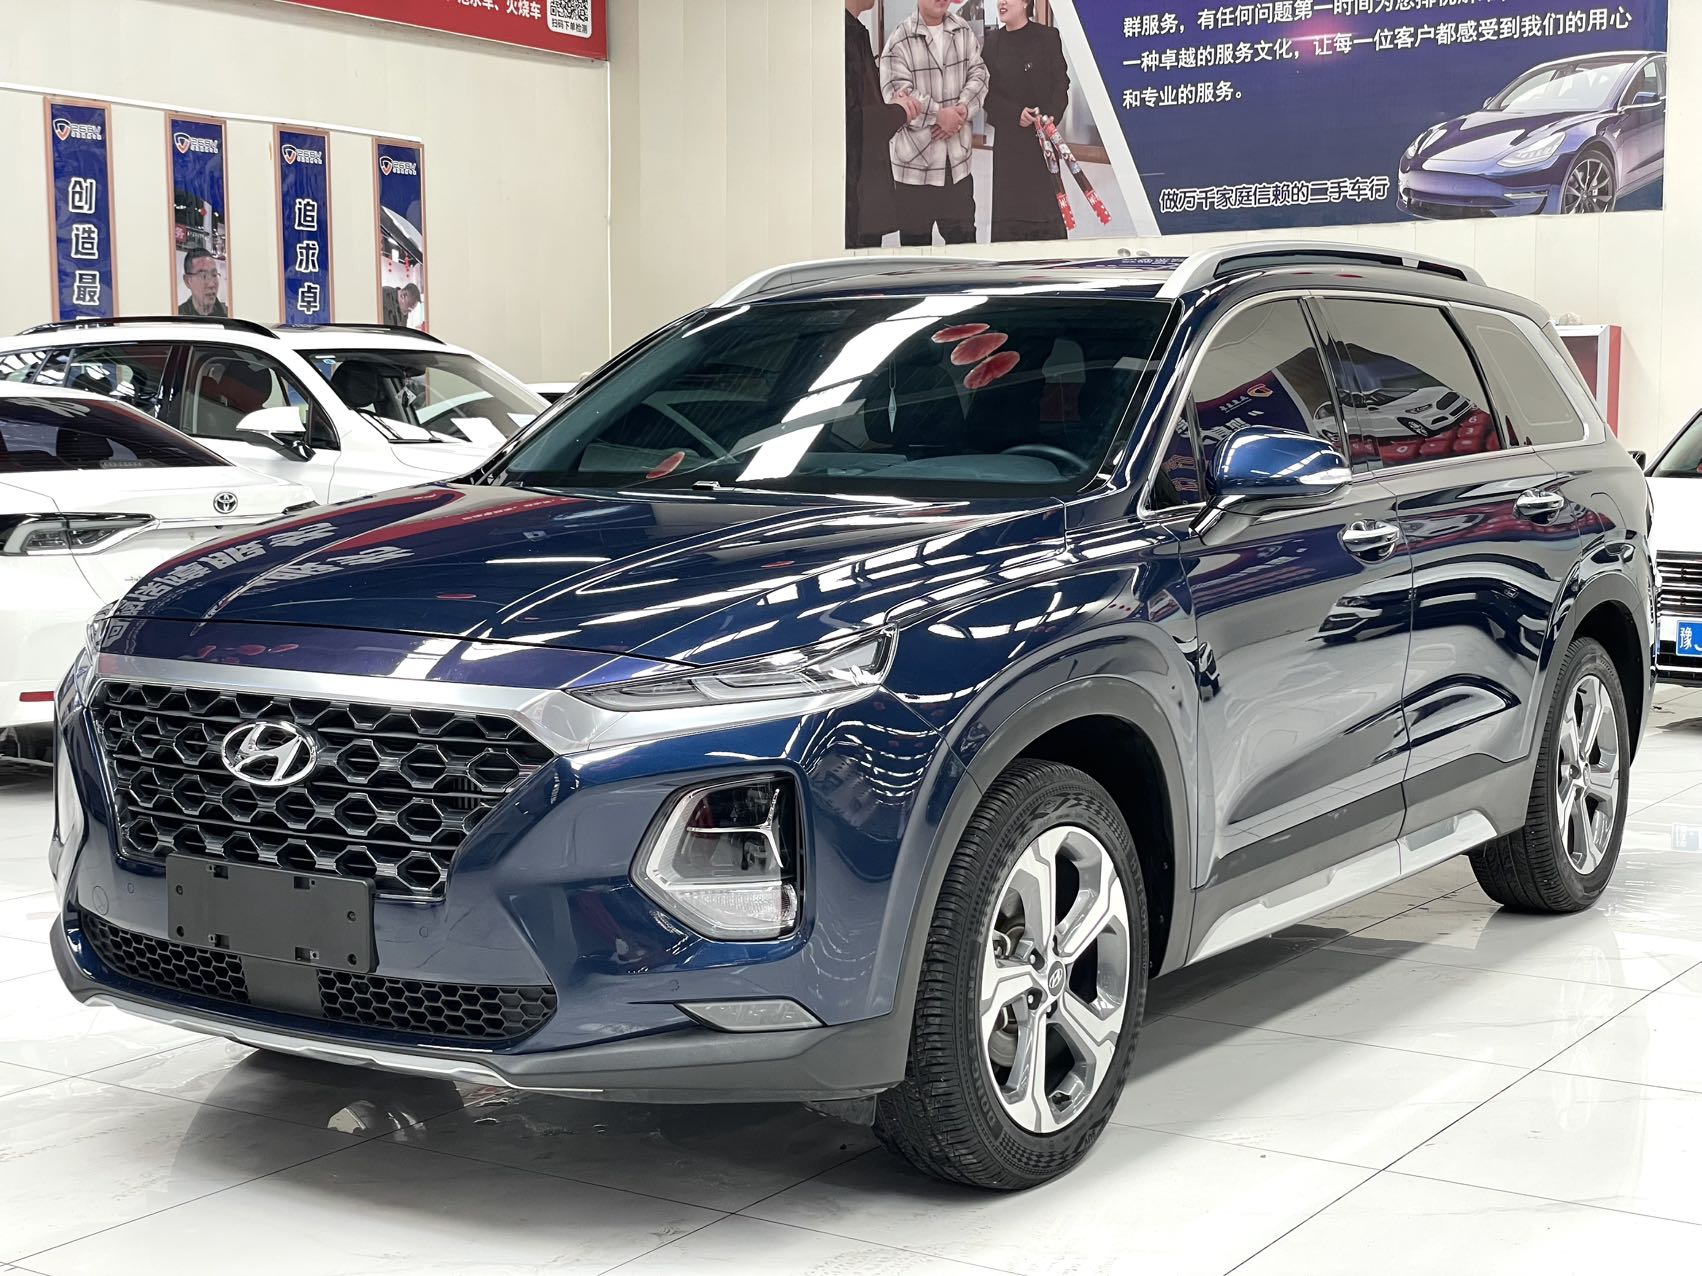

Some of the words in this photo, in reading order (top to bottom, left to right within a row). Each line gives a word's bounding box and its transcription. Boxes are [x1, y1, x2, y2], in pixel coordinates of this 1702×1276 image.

[1123, 80, 1245, 109] 和专业的服务。
[1159, 176, 1390, 213] 做万千家庭信赖的二手车行
[69, 177, 100, 319] 创造最
[295, 199, 319, 314] 追求卓
[1680, 627, 1702, 651] 豫
